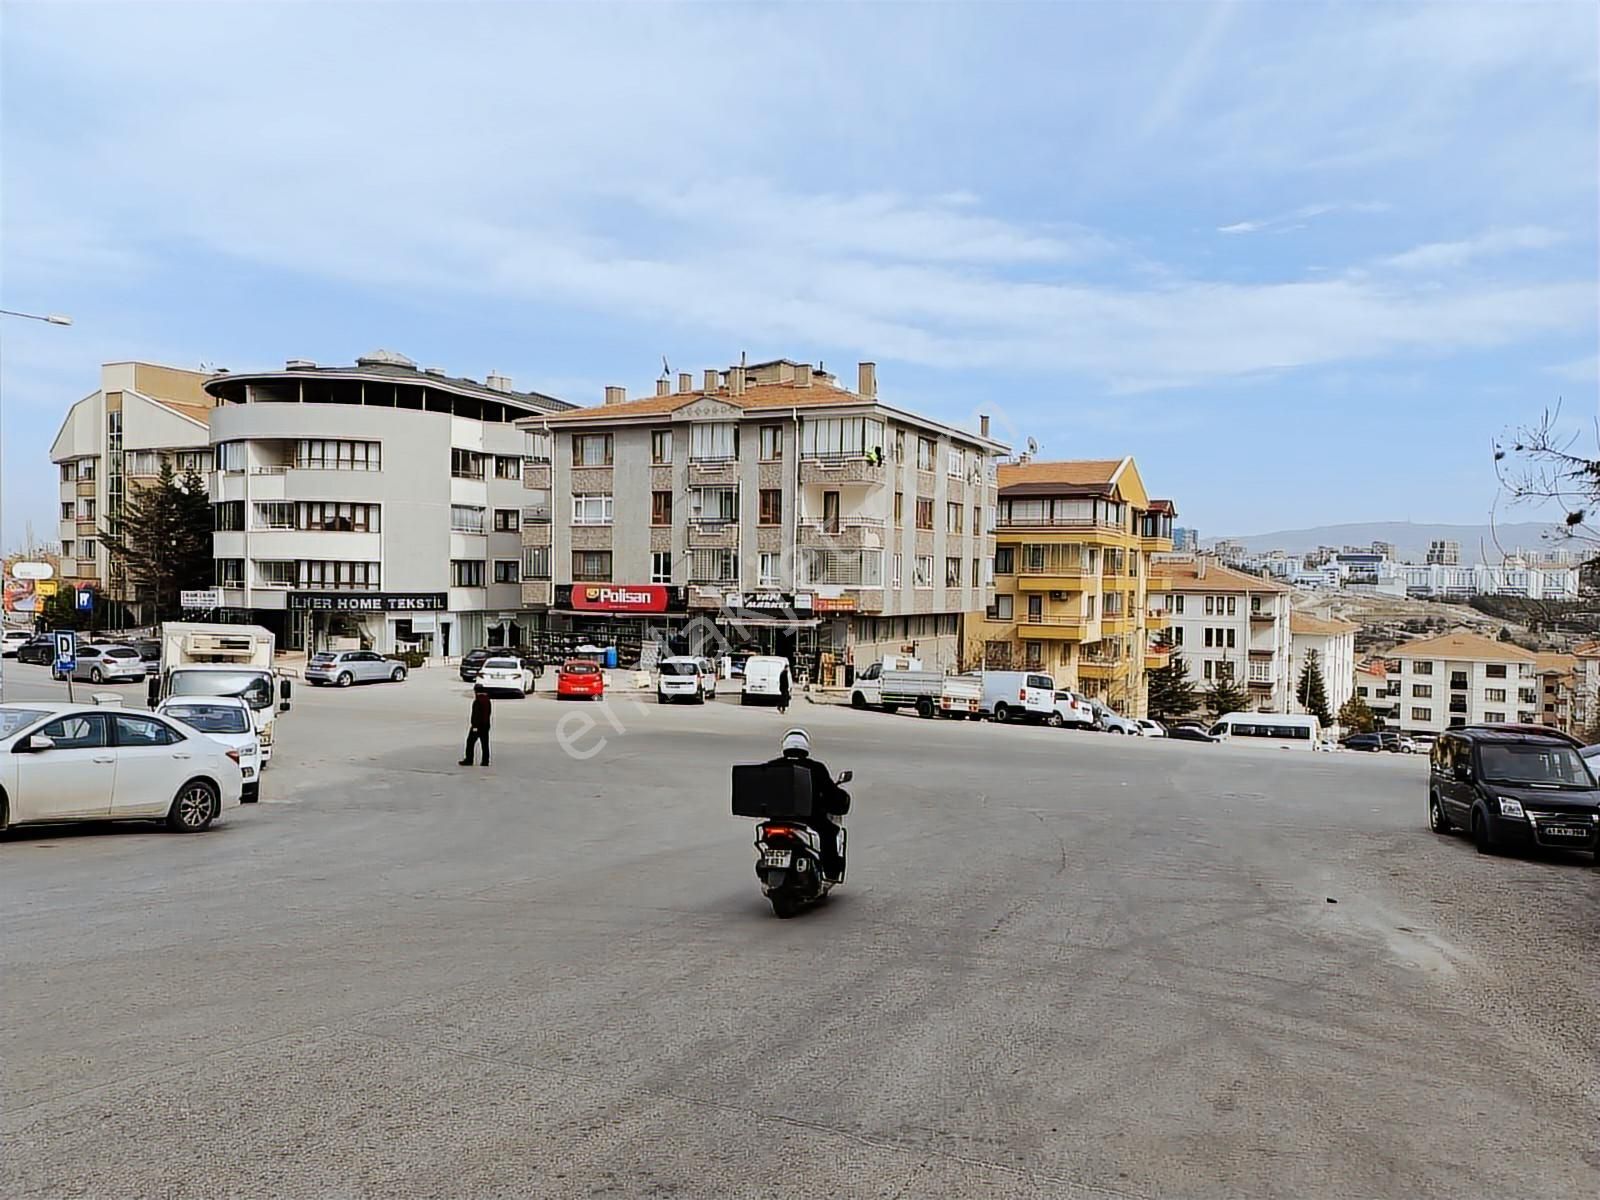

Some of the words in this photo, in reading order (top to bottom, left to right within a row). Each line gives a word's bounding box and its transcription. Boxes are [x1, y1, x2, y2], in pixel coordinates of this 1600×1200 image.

[337, 598, 382, 609] HOME
[600, 588, 651, 604] Polisan
[60, 637, 70, 652] D
